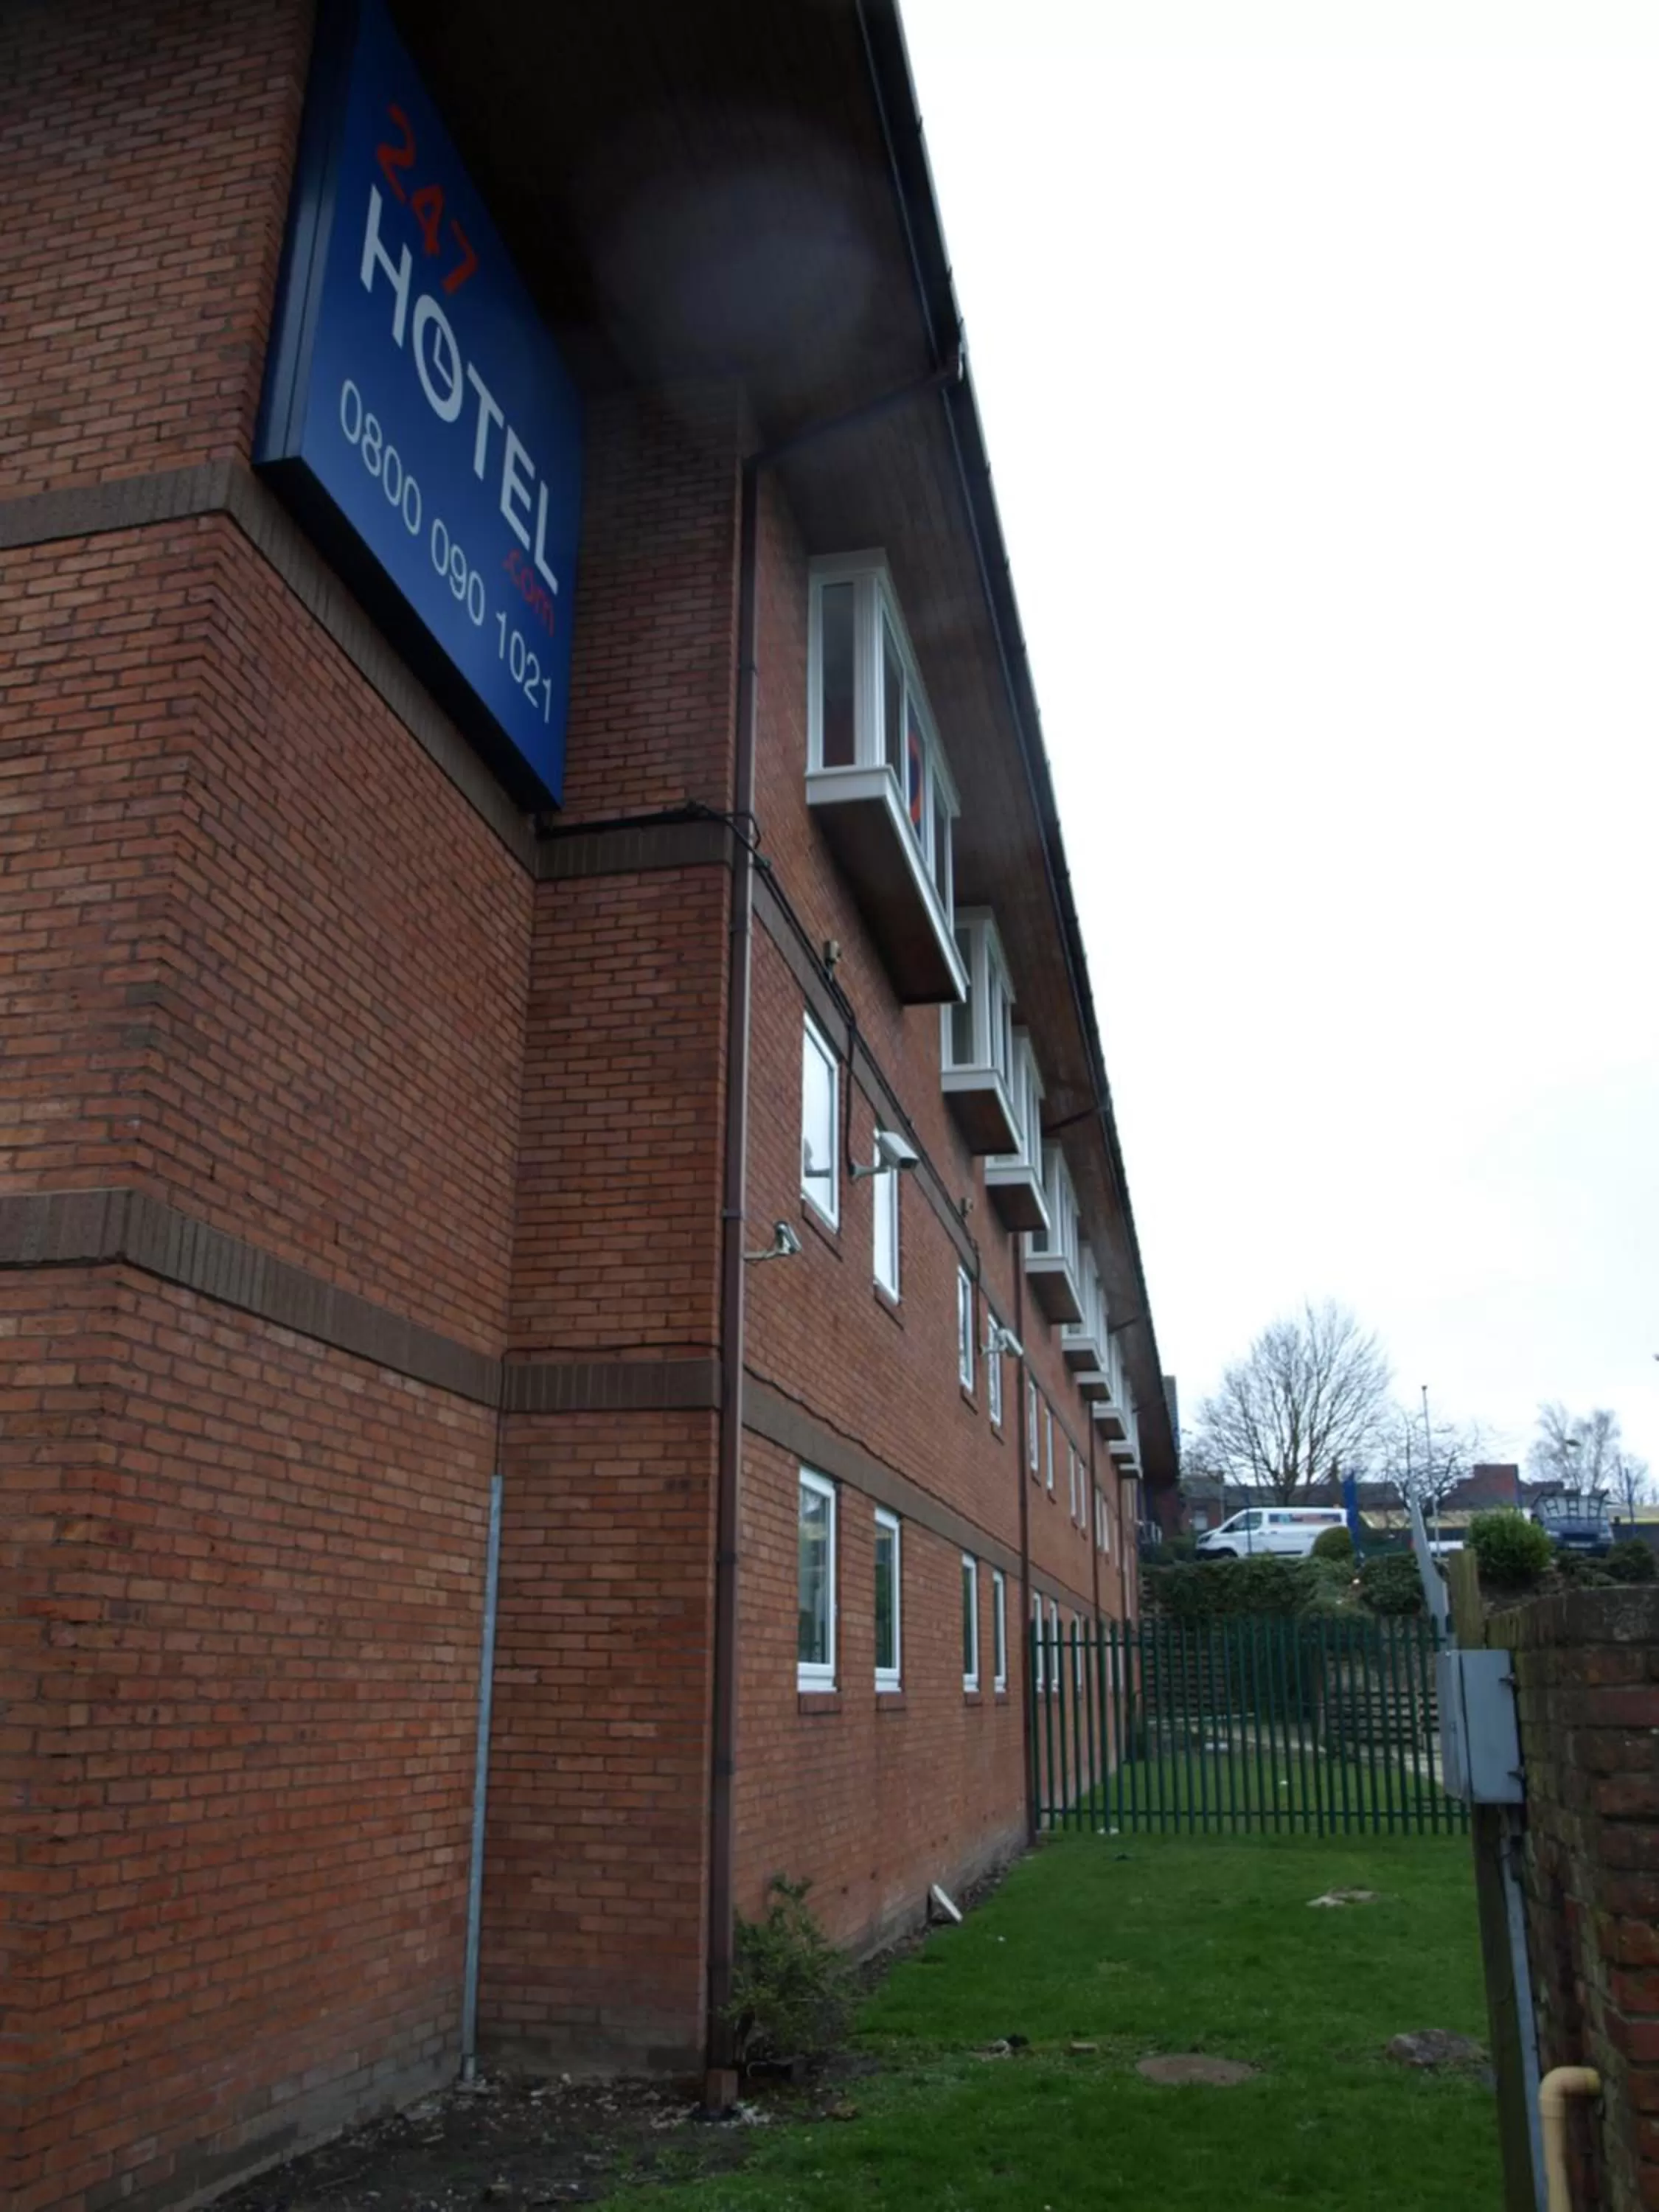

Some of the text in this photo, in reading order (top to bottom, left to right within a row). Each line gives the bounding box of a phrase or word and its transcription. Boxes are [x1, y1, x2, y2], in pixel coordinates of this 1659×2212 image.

[377, 103, 479, 296] 247
[339, 379, 552, 724] 0800 090 1021
[360, 184, 558, 595] HOTEL
